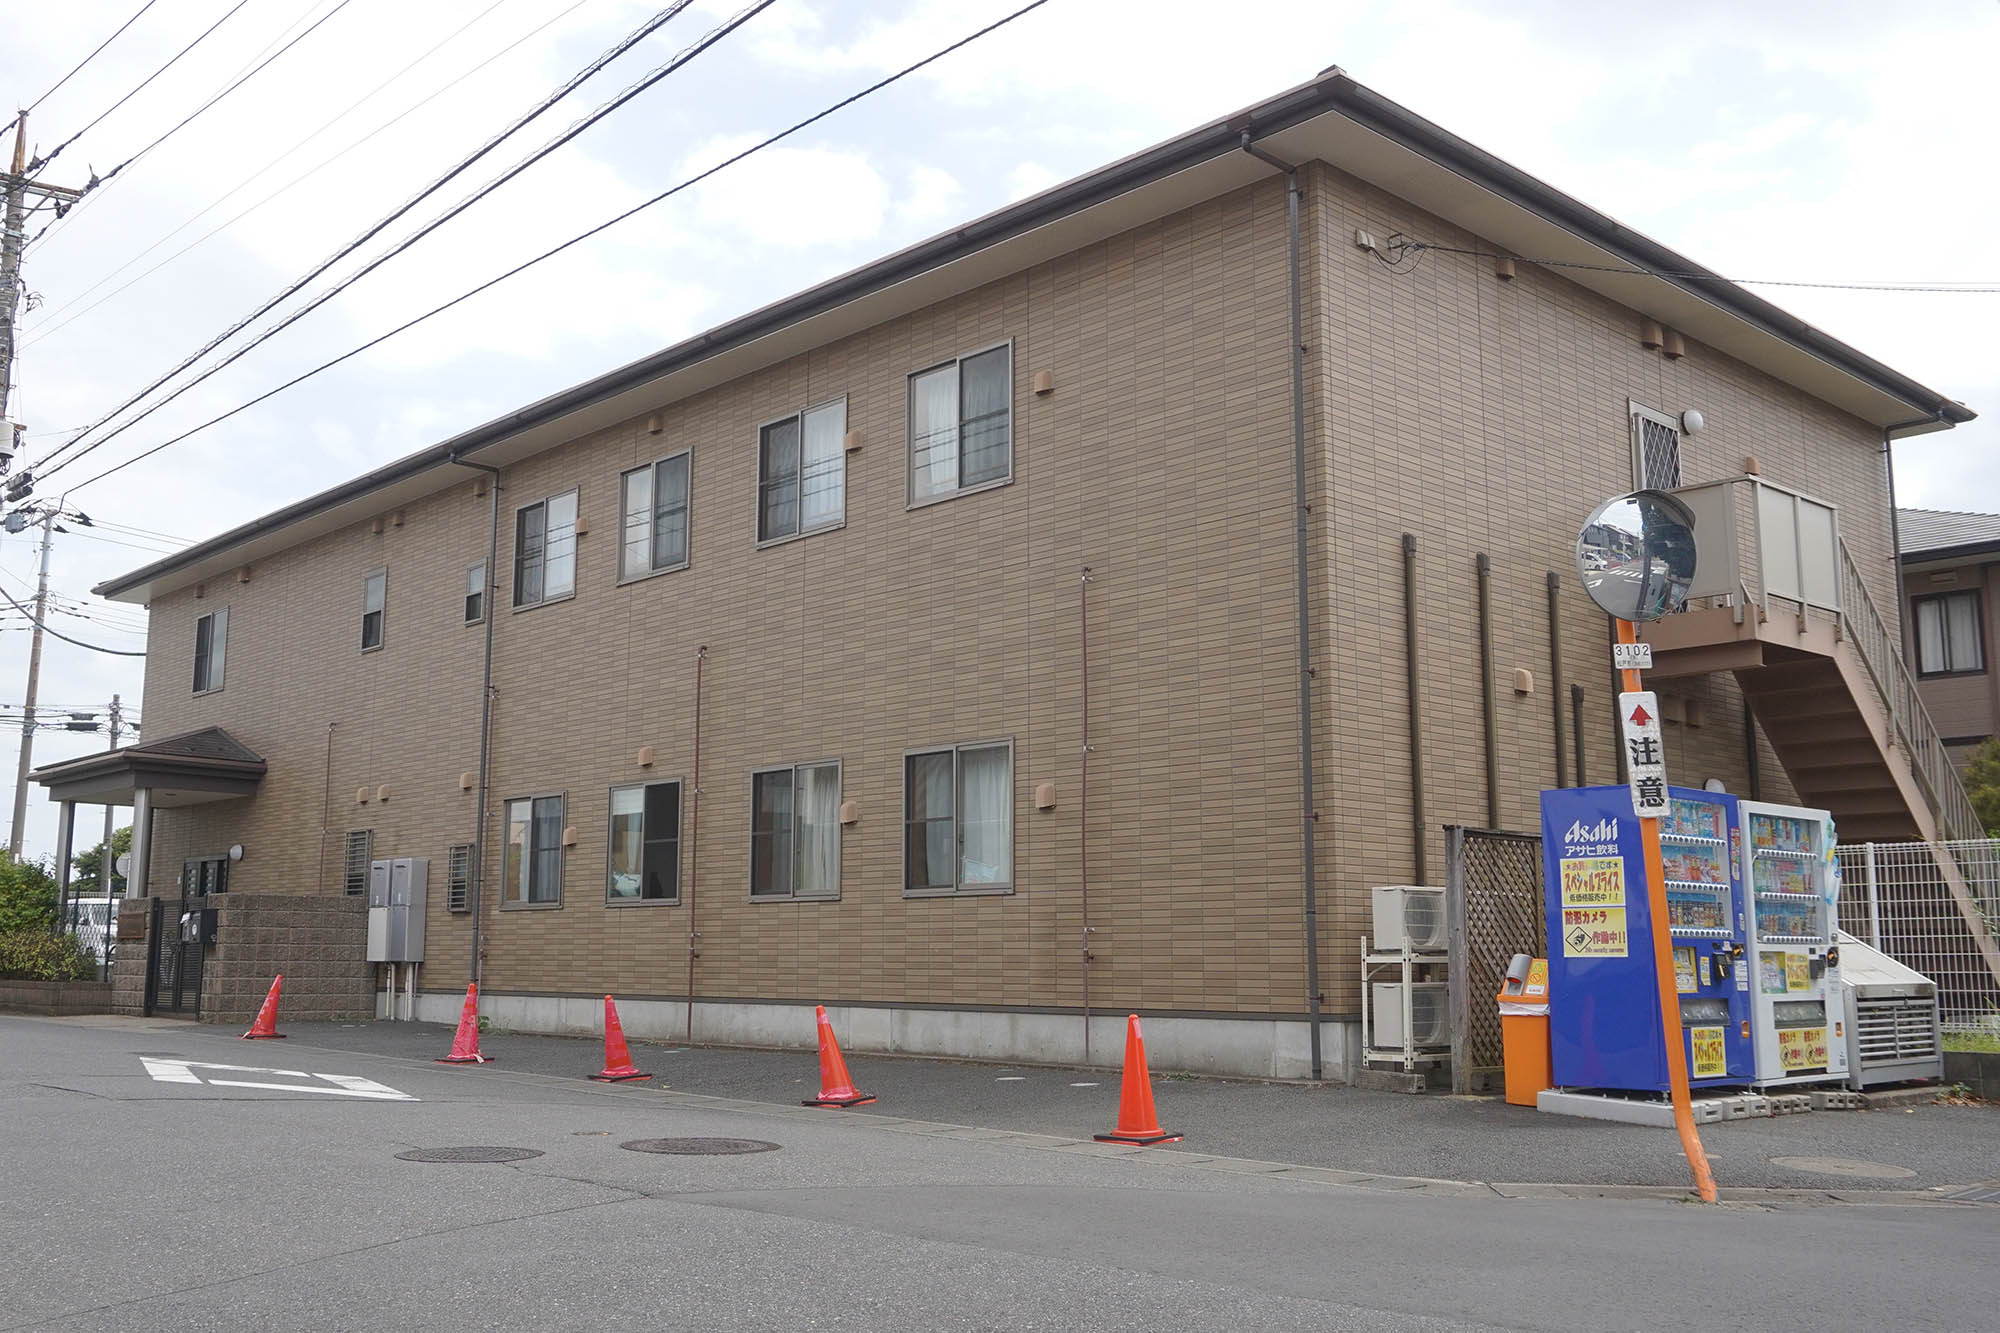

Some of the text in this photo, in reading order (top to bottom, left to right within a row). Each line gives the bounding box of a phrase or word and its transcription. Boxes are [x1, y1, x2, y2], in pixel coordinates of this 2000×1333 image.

[1615, 645, 1650, 656] 3102
[1629, 737, 1665, 808] 注意
[1564, 817, 1618, 844] Asahi
[1564, 844, 1619, 857] アサヒ飲料
[1564, 871, 1620, 892] スペシャルプライス
[1564, 910, 1608, 926] 防犯カメラ
